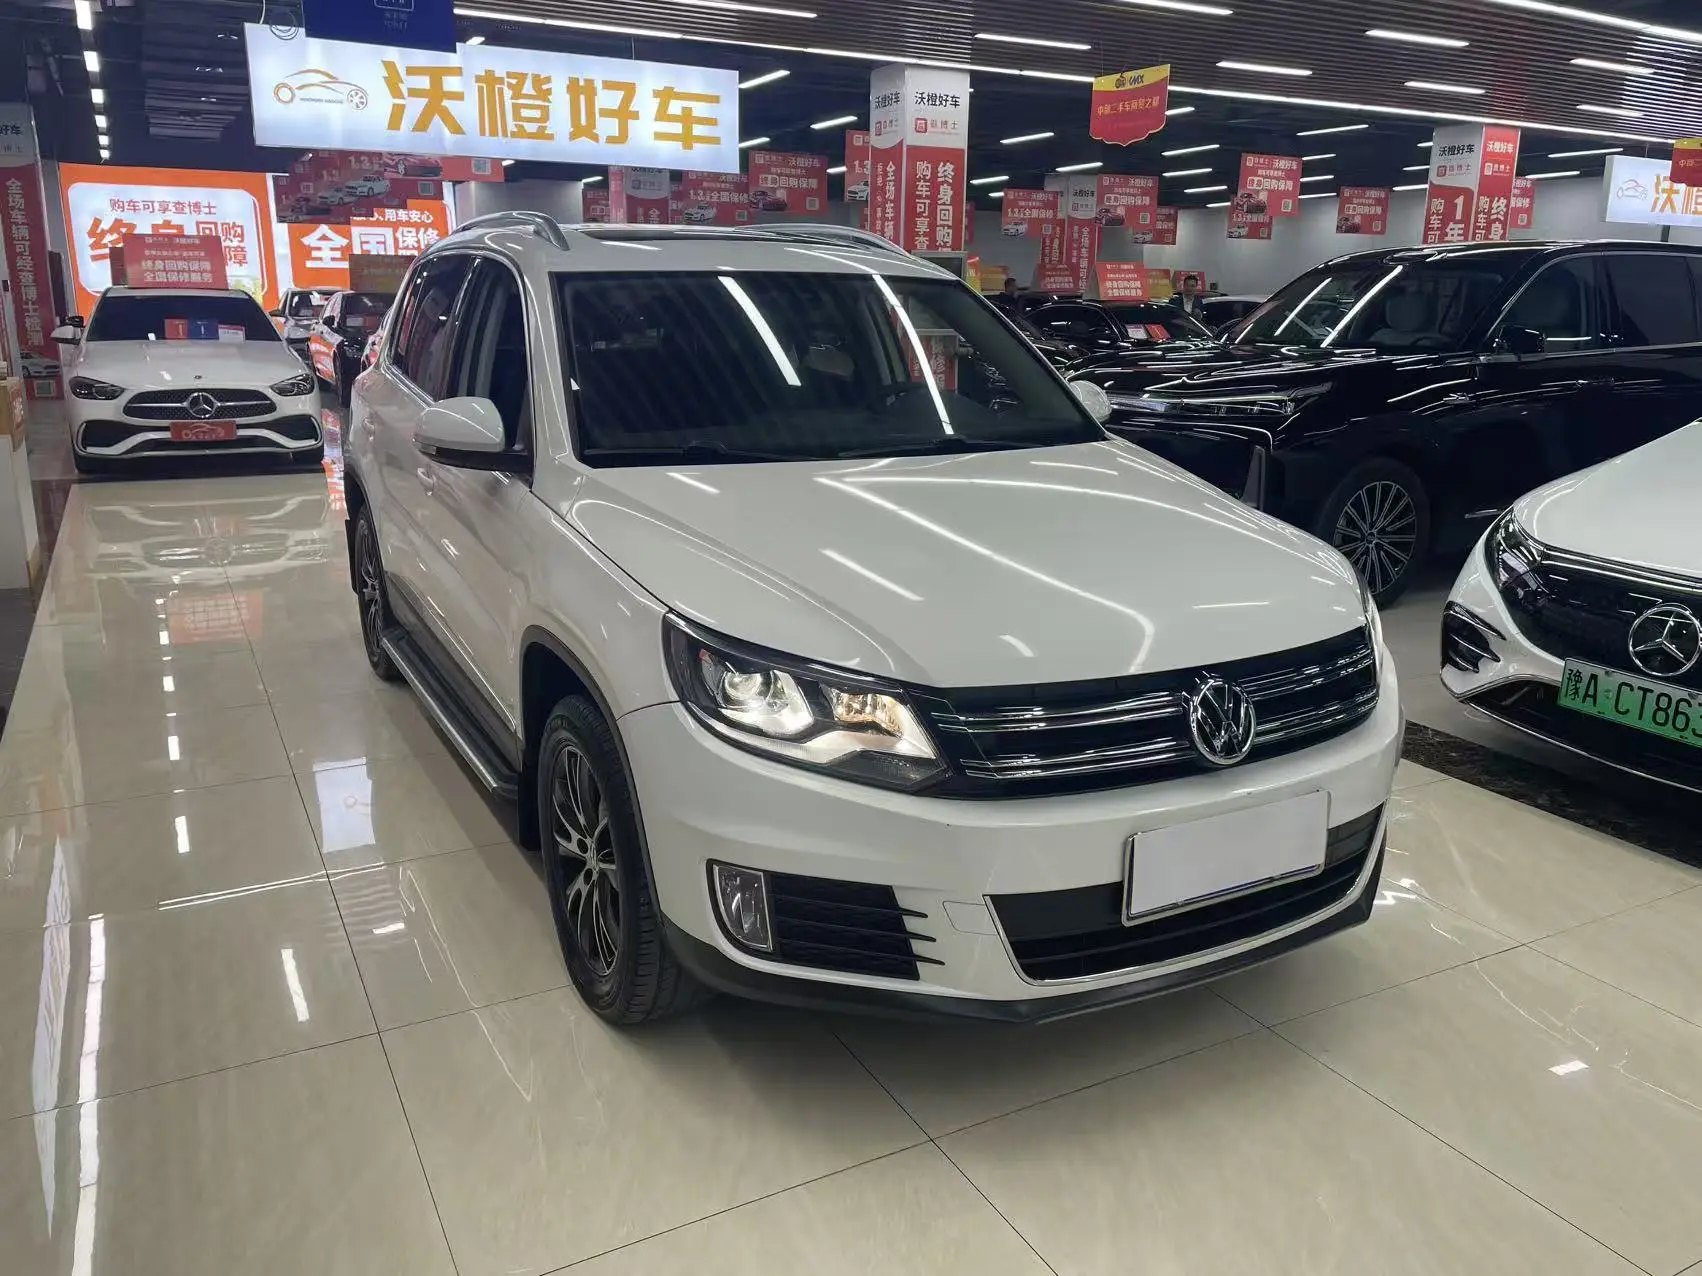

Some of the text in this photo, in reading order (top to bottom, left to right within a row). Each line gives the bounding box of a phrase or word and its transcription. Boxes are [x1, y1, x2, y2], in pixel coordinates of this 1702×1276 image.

[381, 60, 721, 150] 沃橙好车
[875, 91, 900, 109] 沃橙好车
[914, 91, 960, 108] 沃橙好车
[1439, 144, 1475, 156] 沃橙好车
[1486, 141, 1514, 154] 沃橙好车
[110, 199, 217, 215] 购车可享查博士
[936, 161, 955, 252] 终身回购
[1427, 198, 1445, 244] 购车可
[1444, 195, 1465, 241] 1年
[1475, 196, 1490, 241] 购车可
[1488, 196, 1507, 240] 终身
[301, 224, 394, 268] 全国
[395, 226, 439, 249] 保修
[6, 178, 44, 345] 全场车辆可经查博士检测
[142, 259, 212, 272] 终身回购保障
[143, 271, 213, 283] 全国保修服务
[1566, 668, 1599, 707] 豫A
